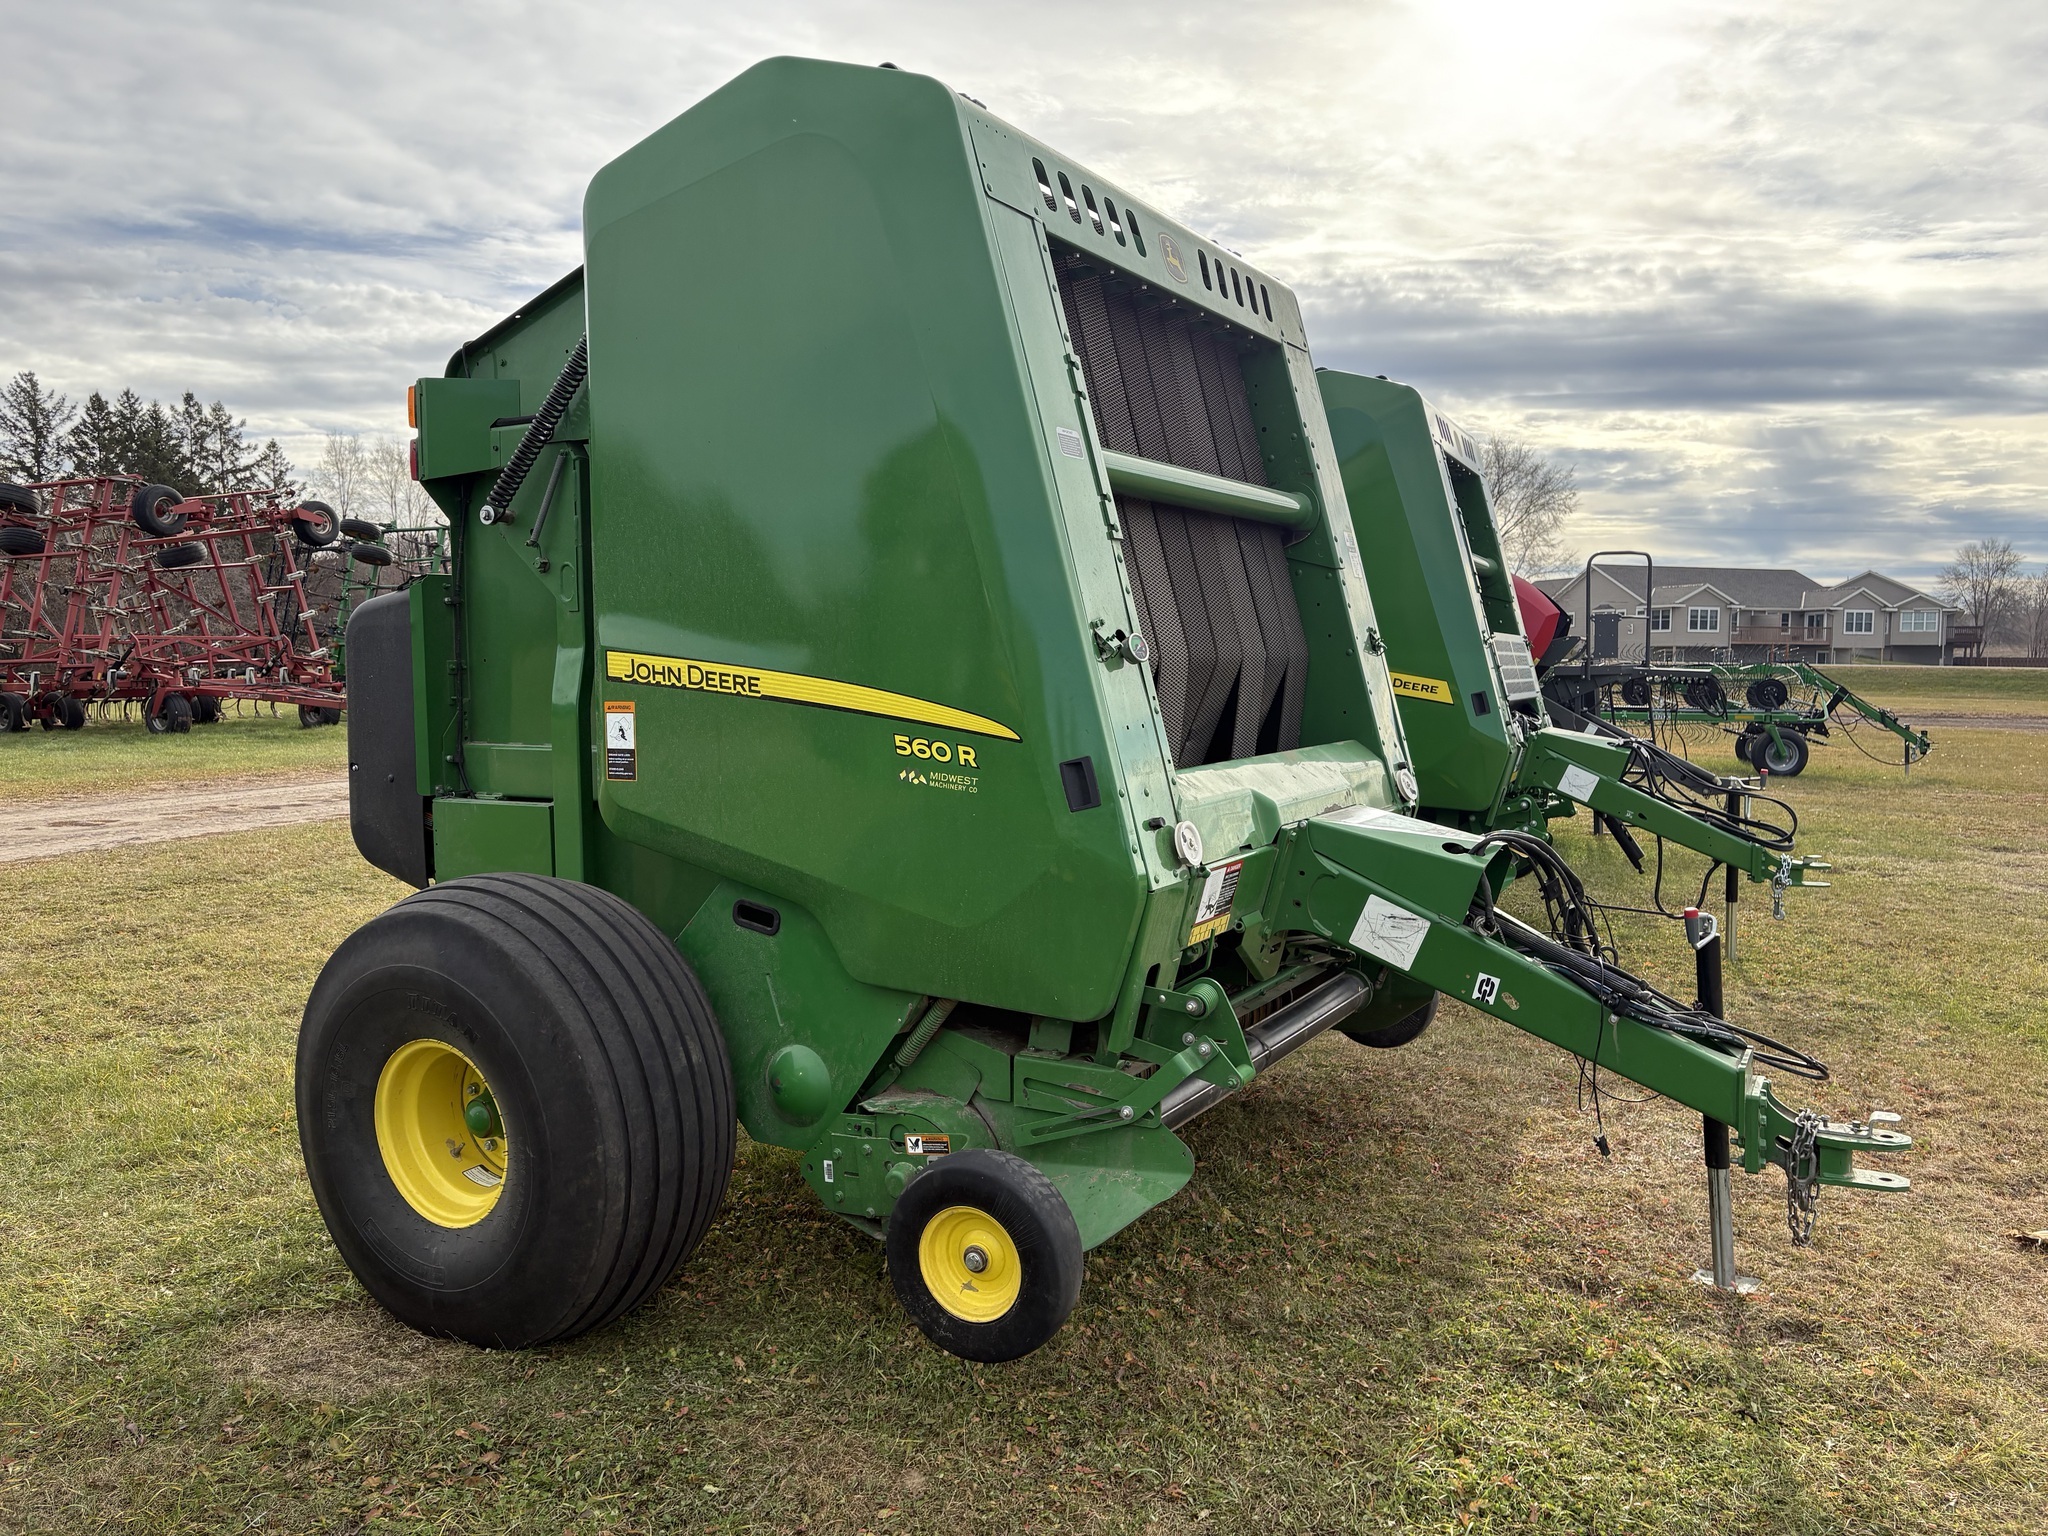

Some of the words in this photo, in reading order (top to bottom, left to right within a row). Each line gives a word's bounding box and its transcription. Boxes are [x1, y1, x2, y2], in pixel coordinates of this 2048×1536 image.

[624, 658, 682, 684] JOHN
[687, 664, 761, 695] DEERE
[1393, 677, 1439, 694] DEERE
[893, 733, 953, 763] 560
[957, 743, 979, 769] R
[929, 771, 979, 786] MIDWEST
[929, 781, 966, 792] MACHINERY
[968, 786, 978, 794] CO
